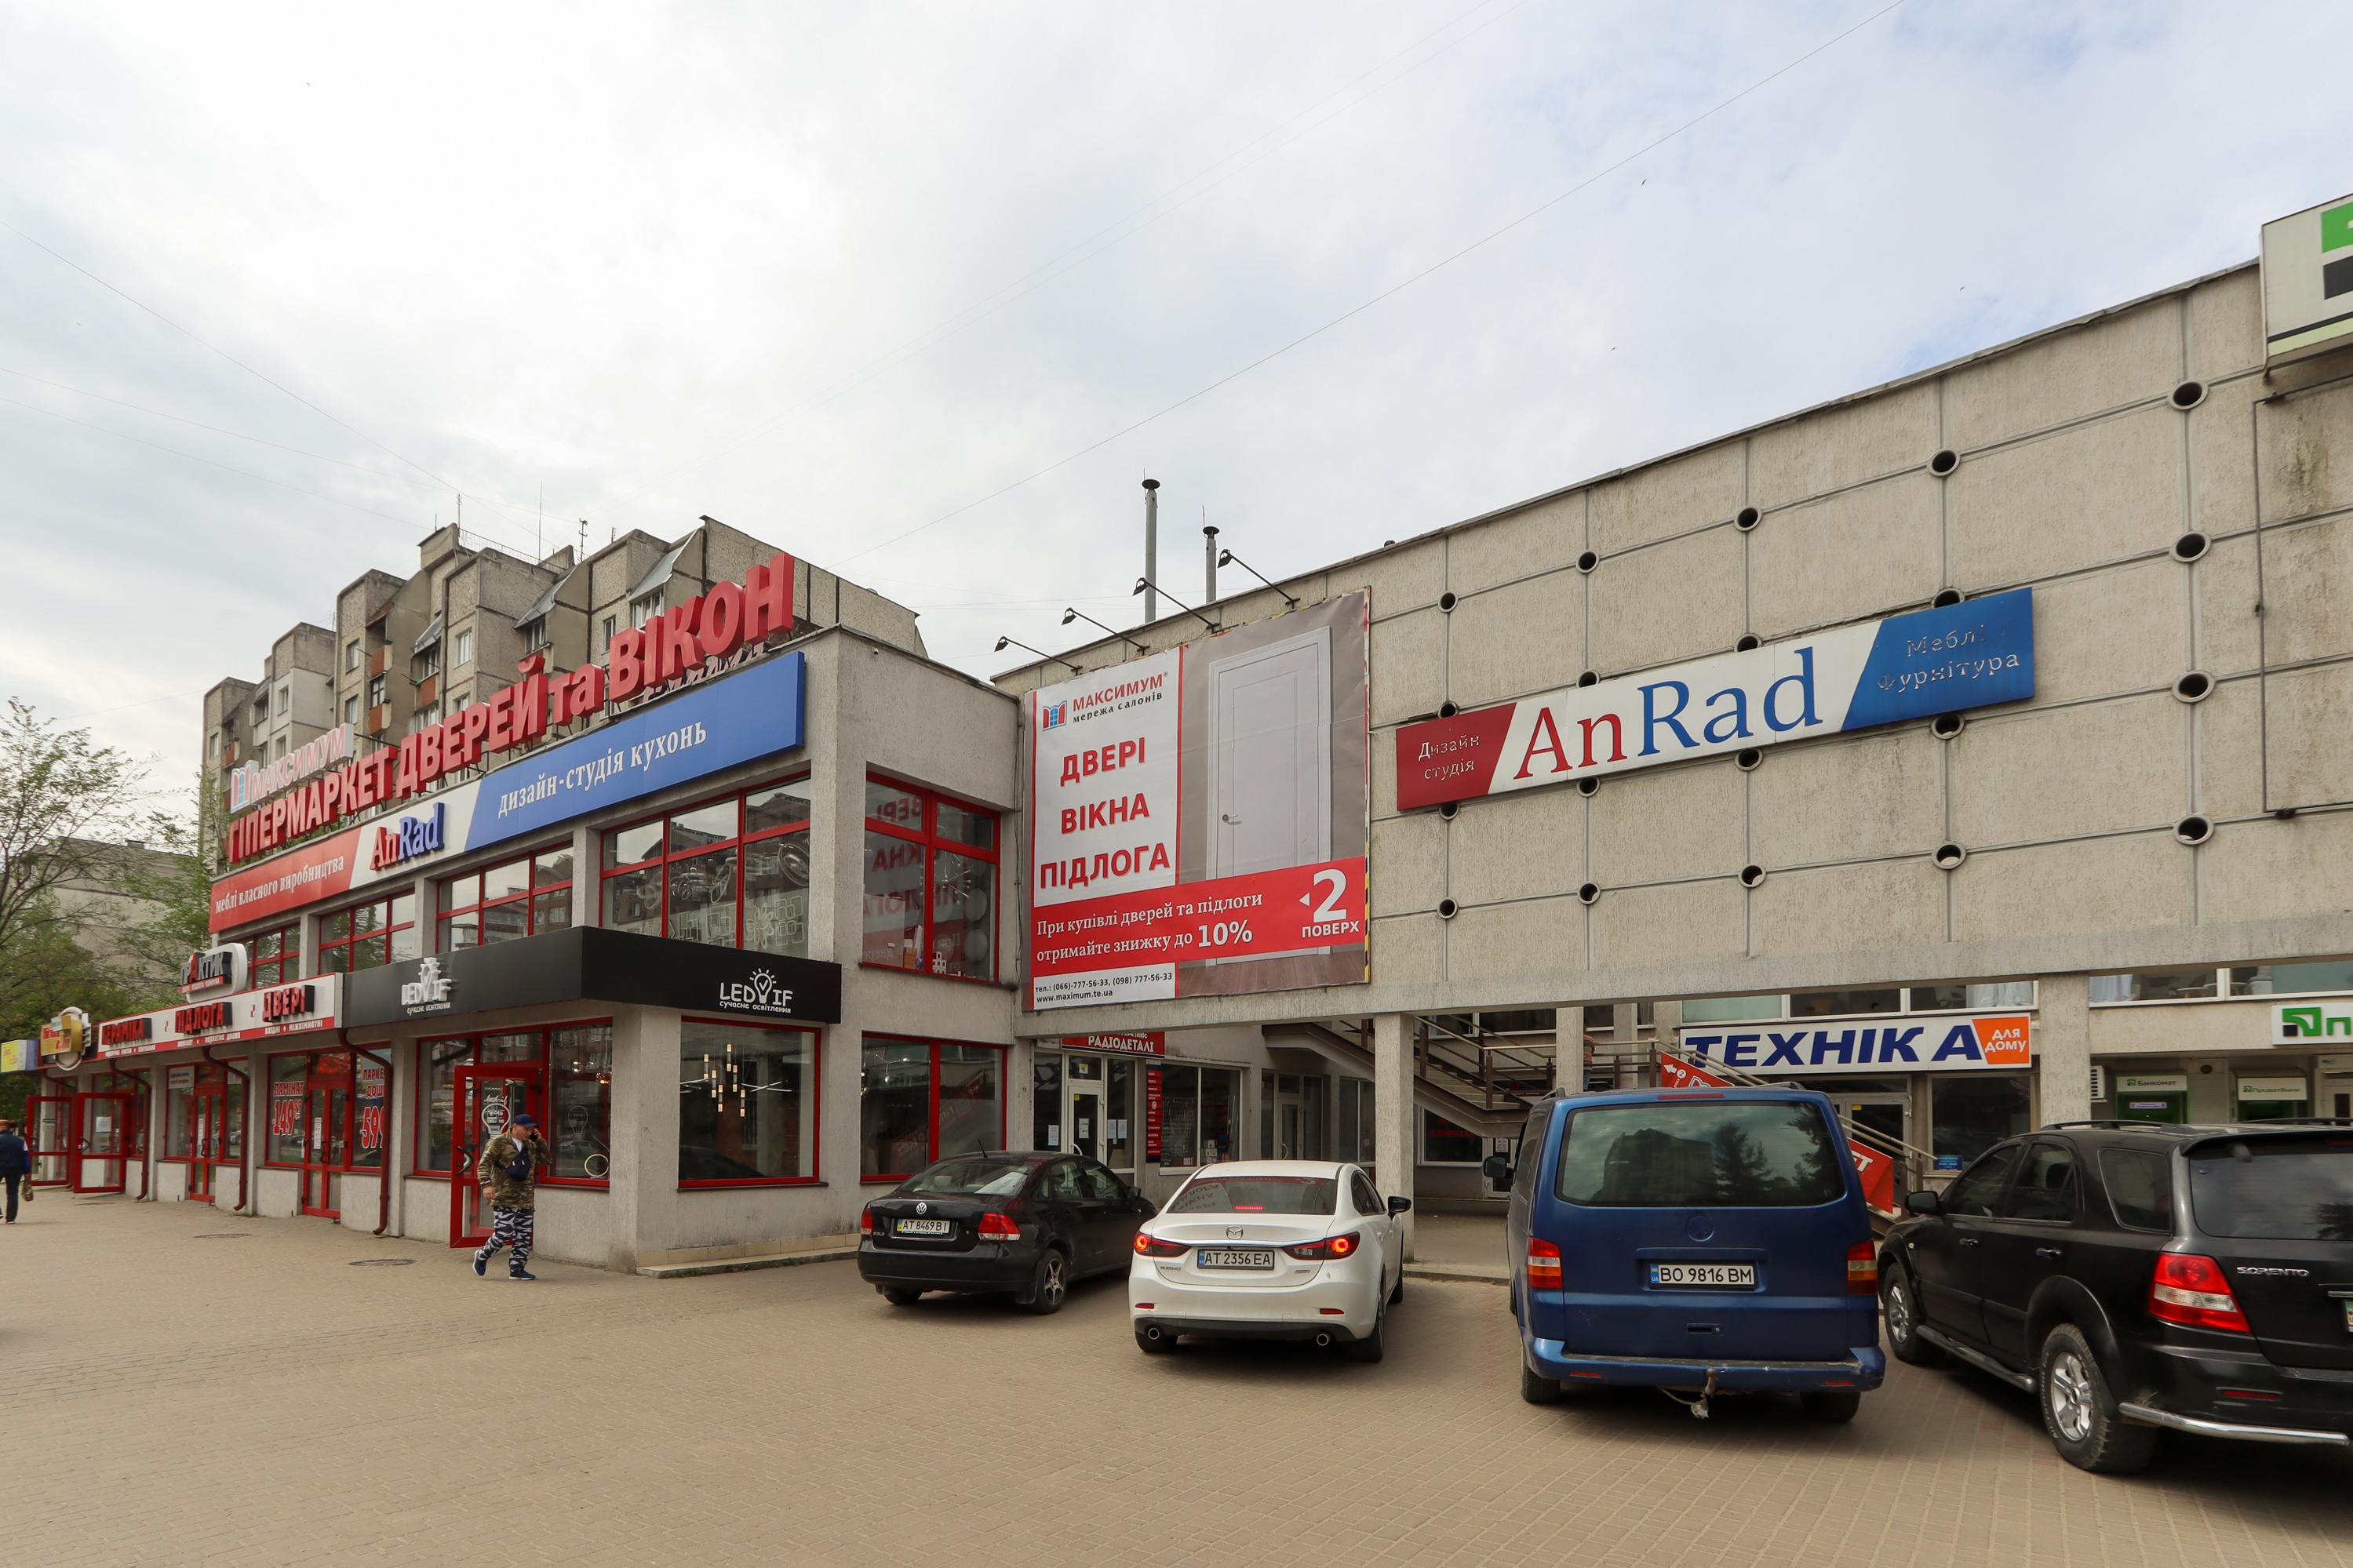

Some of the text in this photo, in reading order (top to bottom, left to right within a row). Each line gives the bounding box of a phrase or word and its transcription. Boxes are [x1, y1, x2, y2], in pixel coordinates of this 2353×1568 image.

[1906, 624, 1986, 657] Меблі
[228, 746, 397, 864] ГІПЕРМАРКЕТ
[395, 656, 548, 799] ДВЕРЕЙ
[548, 662, 605, 727] та
[608, 553, 794, 704] ВІКОН
[1073, 673, 1163, 712] МАКСИМУМ
[1073, 691, 1163, 723] мережа салонів
[1513, 646, 1823, 781] AnRad
[252, 722, 354, 802] МАКСИМУМ
[1060, 737, 1146, 788] ДВЕРІ
[1418, 734, 1480, 762] Дизайн
[497, 720, 707, 819] дизайн-студія кухонь
[1424, 759, 1475, 780] студія
[1061, 792, 1150, 835] ВІКНА
[369, 802, 446, 871] AnRad
[1040, 842, 1171, 890] ПІДЛОГА
[215, 855, 344, 915] меблі власного виробництва
[1312, 868, 1348, 924] 2
[1036, 893, 1263, 938] При купівлі дверей та підлоги
[1301, 919, 1360, 940] ПОВЕРХ
[1036, 919, 1254, 965] отримайте знижку до 10%
[180, 951, 225, 987] ПРАКТИК
[1035, 972, 1173, 993] тел.: (066)-777-56-33, (098) 777-56-33
[262, 985, 307, 1023] ДВЕРІ
[719, 1000, 792, 1013] сучасне освітлення
[1036, 988, 1113, 1003] www.maximum.te.ua
[175, 1002, 225, 1035] ПІДЛОГА
[1087, 1035, 1154, 1053] РАДІОДЕТАЛІ
[1685, 1024, 1983, 1068] ТЕХНІКА
[273, 1081, 304, 1097] ЛАМІНАТ
[1204, 1253, 1271, 1265] AT 2356 EA
[1660, 1267, 1752, 1283] BO 9816 BM
[2236, 1266, 2310, 1277] SORENTO
